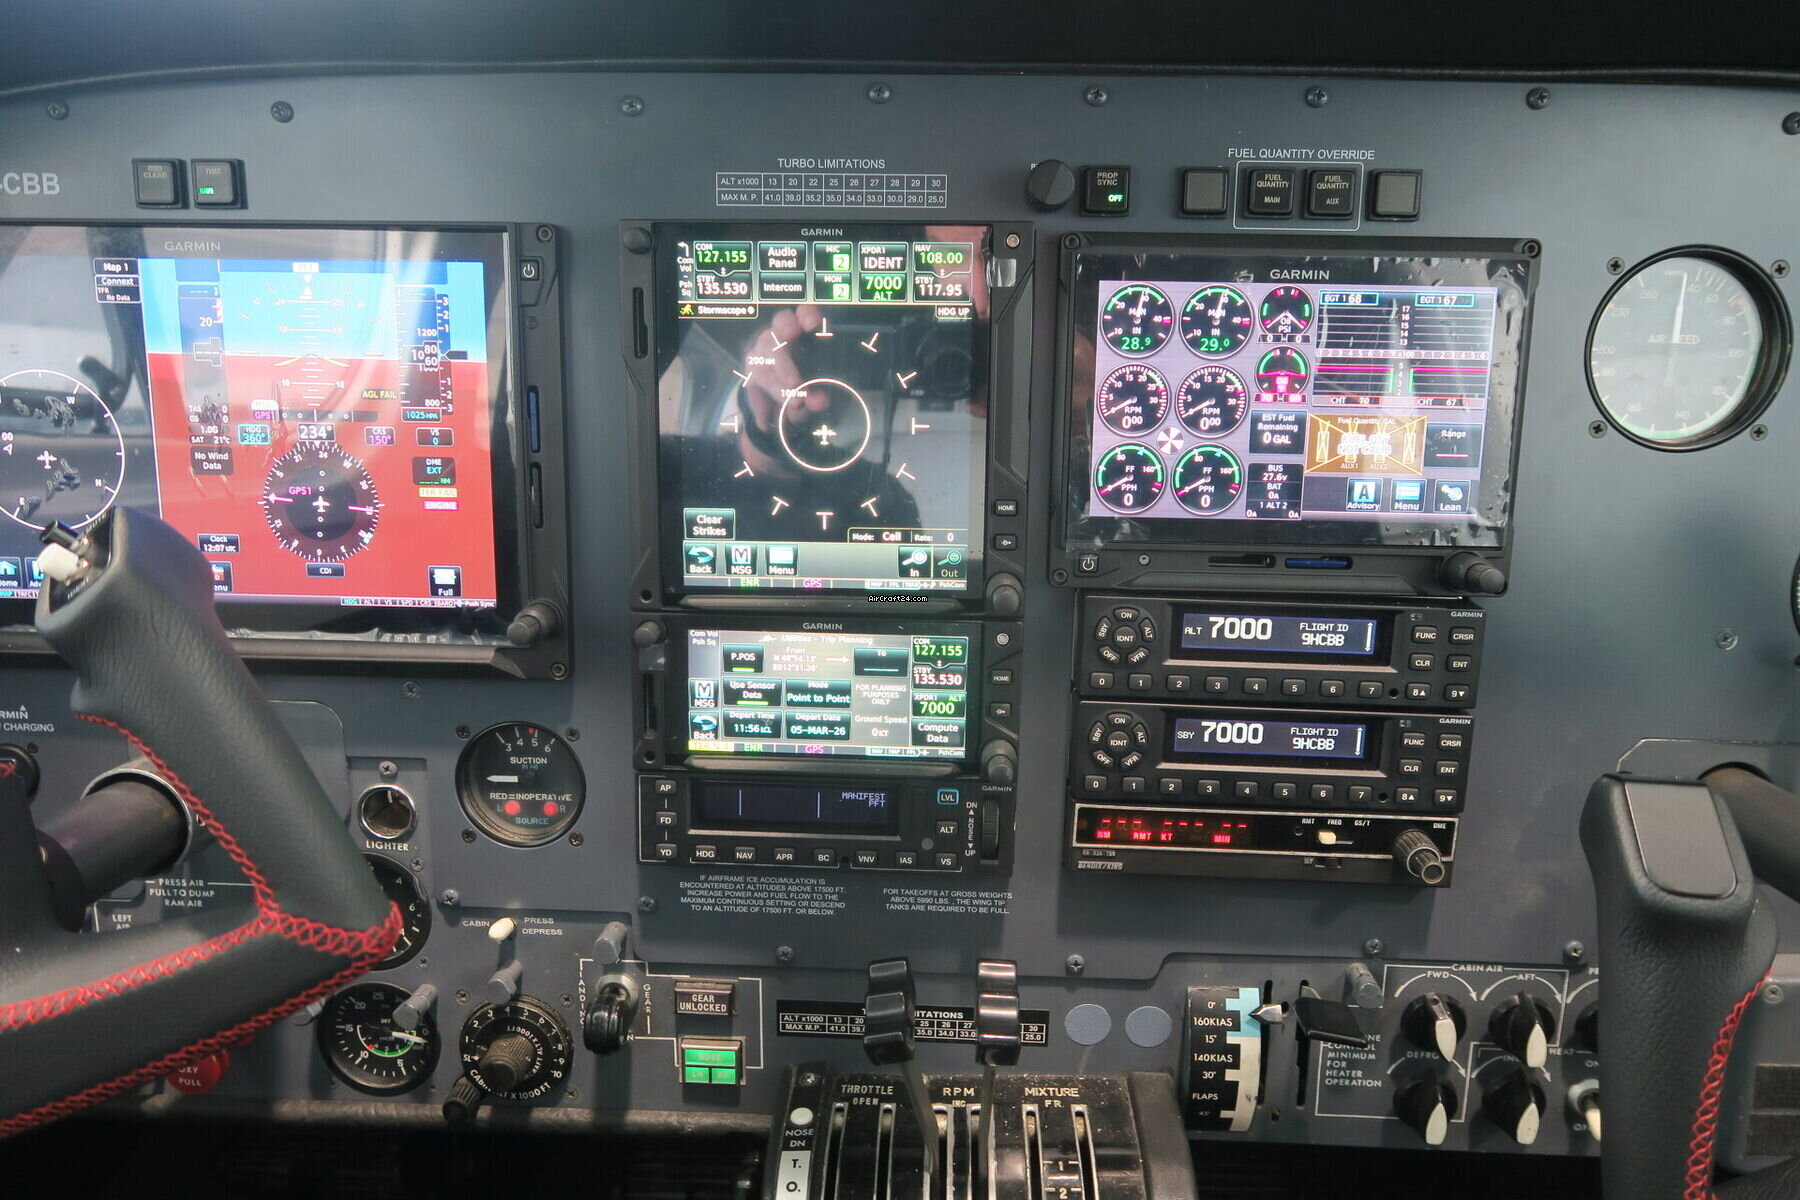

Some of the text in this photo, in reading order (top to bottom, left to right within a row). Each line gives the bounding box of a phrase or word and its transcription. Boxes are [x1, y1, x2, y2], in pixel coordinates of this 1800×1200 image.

[1229, 148, 1375, 160] FUEL QUANTITY OVERRIDE
[778, 159, 885, 168] TURBO LIMITATIONS
[1097, 178, 1118, 186] SYNC
[1257, 180, 1289, 189] QUANTITY
[1316, 182, 1349, 191] QUANTITY
[1108, 194, 1123, 202] OFF
[801, 228, 843, 236] GARMIN
[165, 241, 221, 251] GARMIN
[768, 247, 797, 257] Audio
[697, 251, 747, 263] 127.155
[920, 252, 963, 264] 108.00
[769, 258, 796, 268] Panel
[864, 257, 903, 269] IDENT
[1270, 269, 1330, 280] GARMIN
[764, 283, 802, 291] Intercom
[865, 276, 902, 290] 7000
[697, 283, 747, 295] 135.530
[920, 284, 962, 296] 117.95
[698, 306, 746, 316] Stormscope
[938, 307, 969, 316] HDG UP
[362, 391, 397, 399] AGL FAIL
[1258, 423, 1298, 432] Remaining
[195, 452, 228, 460] No Wind
[203, 462, 221, 470] Data
[1347, 502, 1380, 511] Advisory
[1395, 502, 1419, 511] Menu
[697, 515, 722, 524] Clear
[693, 526, 727, 536] Strikes
[690, 565, 712, 573] Back
[731, 566, 752, 574] MSG
[769, 566, 794, 574] Menu
[941, 569, 958, 577] Out
[1185, 616, 1272, 640] ALT 7000
[1300, 623, 1348, 632] FLIGHT ID
[1302, 633, 1344, 647] 9HCBB
[1416, 632, 1436, 640] FUNC
[1453, 633, 1474, 641] CRSR
[914, 645, 962, 656] 127.155
[731, 653, 756, 661] P.POS
[914, 674, 962, 685] 135.530
[743, 691, 763, 699] Data
[787, 694, 850, 703] Point to Point
[920, 702, 955, 714] 7000
[4, 723, 54, 732] CHARGING
[918, 723, 958, 732] Compute
[1291, 728, 1338, 736] FLIGHT ID
[1177, 722, 1264, 744] SBY 7000
[927, 734, 948, 743] Data
[1293, 737, 1335, 751] 9HCBB
[842, 792, 885, 800] MANIFEST
[941, 794, 955, 802] LVL
[366, 841, 409, 851] LIGHTER
[1452, 964, 1482, 972] CABIN
[1427, 971, 1449, 979] FWD
[692, 994, 715, 1003] GEAR
[680, 1004, 727, 1012] UNLOCKED
[1194, 1017, 1233, 1026] 160KIAS
[1194, 1053, 1233, 1063] 140KIAS
[1327, 1052, 1376, 1060] MINIMUM
[1326, 1070, 1363, 1078] HEATER
[1325, 1079, 1382, 1087] OPERATION
[841, 1085, 894, 1095] THROTTLE
[943, 1087, 975, 1097] RPM
[1024, 1087, 1079, 1097] MIXTURE
[785, 1128, 814, 1137] NOSE
